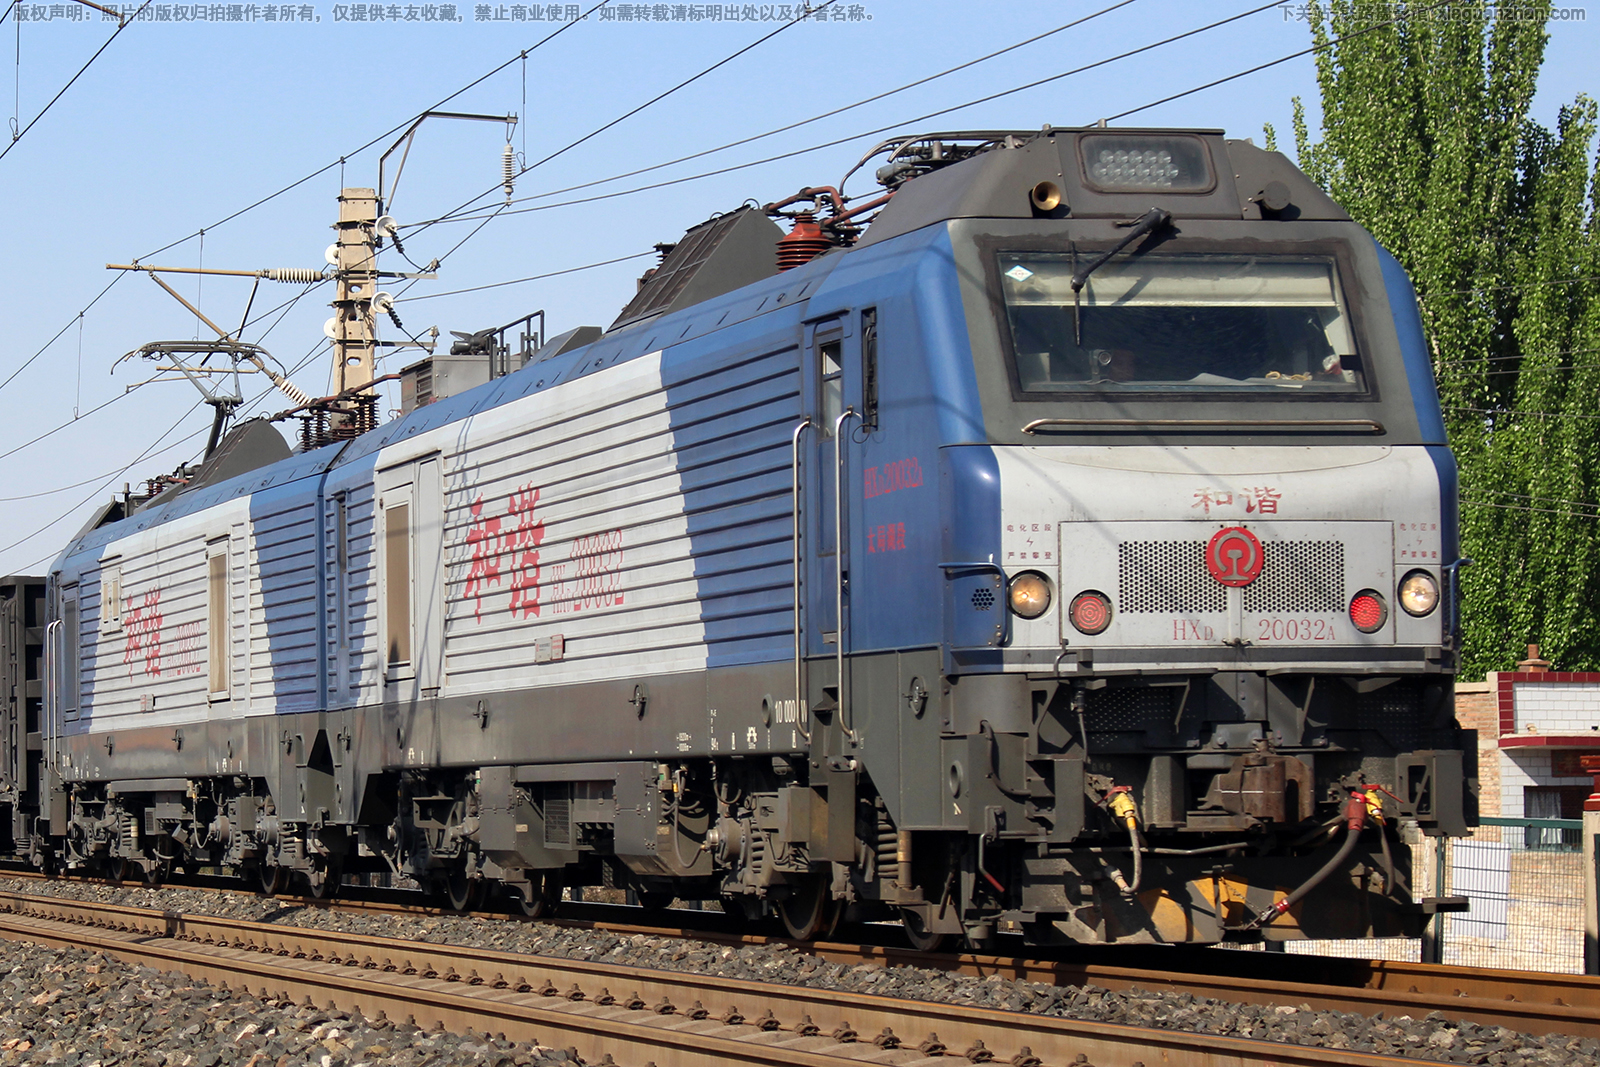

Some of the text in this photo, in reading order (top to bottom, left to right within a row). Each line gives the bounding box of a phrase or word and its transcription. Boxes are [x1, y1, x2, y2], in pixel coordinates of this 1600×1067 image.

[1191, 486, 1282, 514] 和谐
[1006, 523, 1052, 532] 电化区段
[463, 480, 545, 625] 和谐
[1007, 551, 1052, 560] 严禁攀登
[1173, 619, 1336, 641] HXD 20032A
